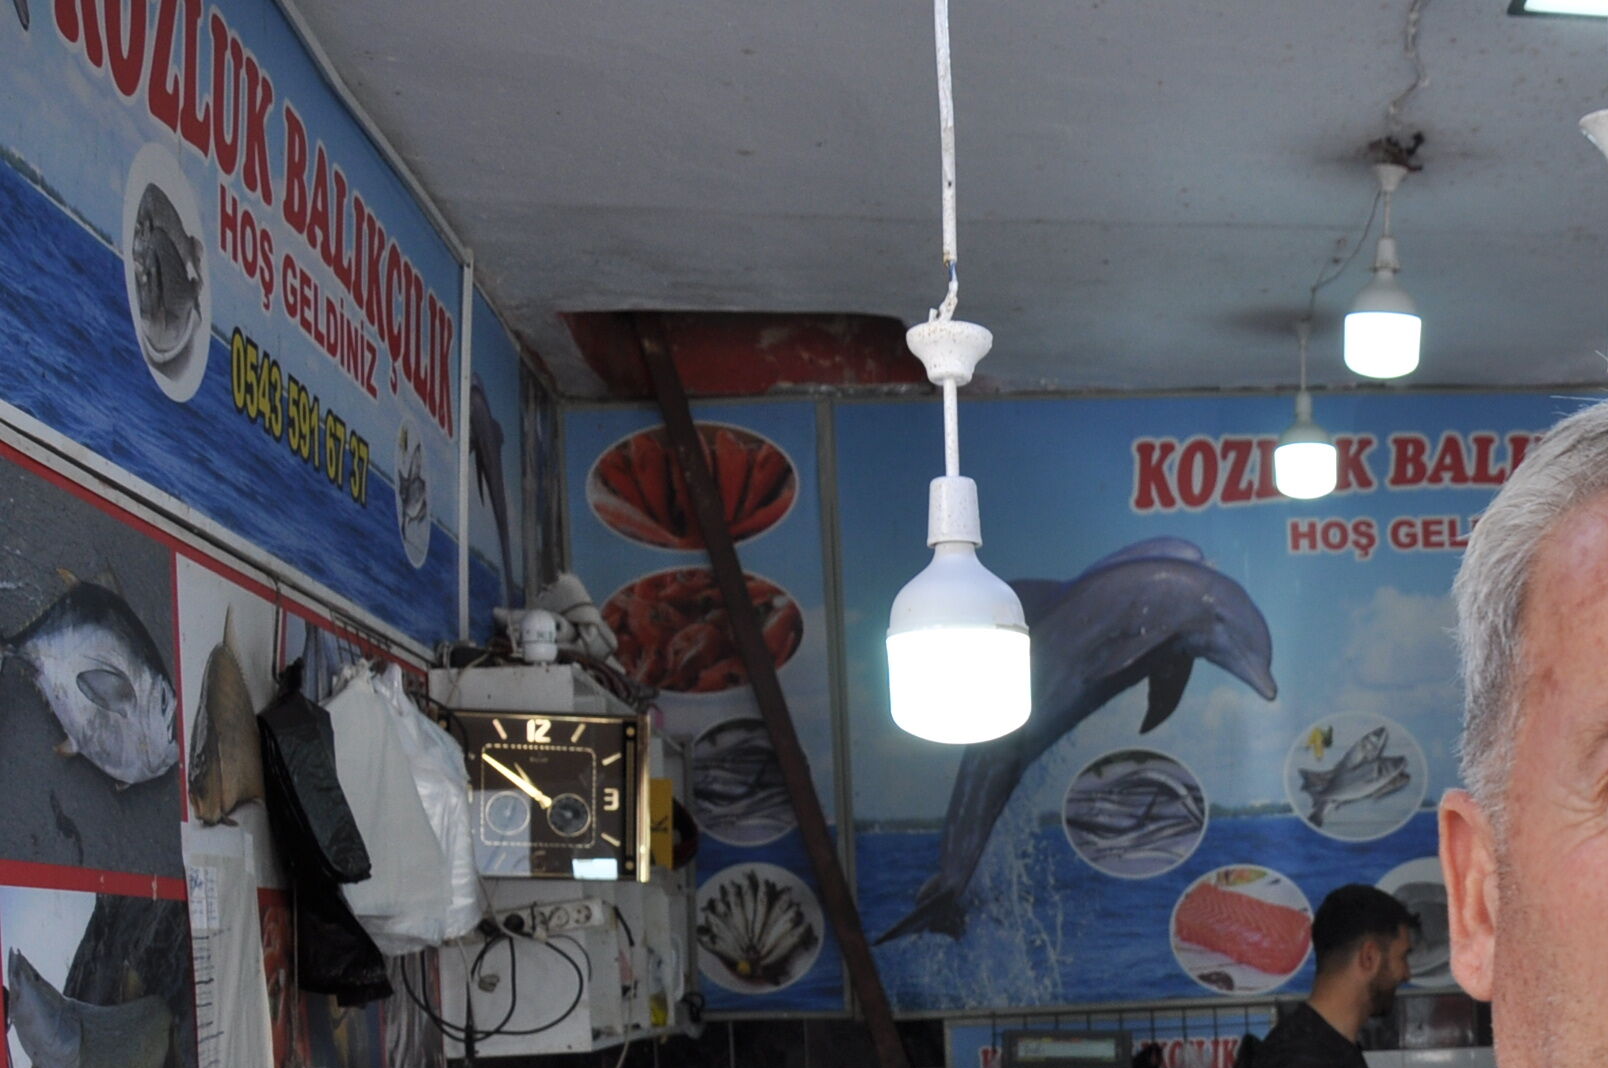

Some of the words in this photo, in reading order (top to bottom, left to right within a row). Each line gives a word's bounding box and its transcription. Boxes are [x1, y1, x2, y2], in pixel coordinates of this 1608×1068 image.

[219, 183, 274, 311] HOŞ
[282, 253, 378, 399] GELDİNİZ
[284, 105, 454, 438] BALIKÇILIK
[231, 327, 284, 443] 0543
[287, 373, 321, 472] 591
[325, 409, 347, 493] 67
[349, 430, 371, 509] 37
[1133, 438, 1374, 510] KOZLK
[1290, 519, 1377, 556] HOŞ
[526, 718, 552, 743] 12
[603, 787, 620, 811] 3
